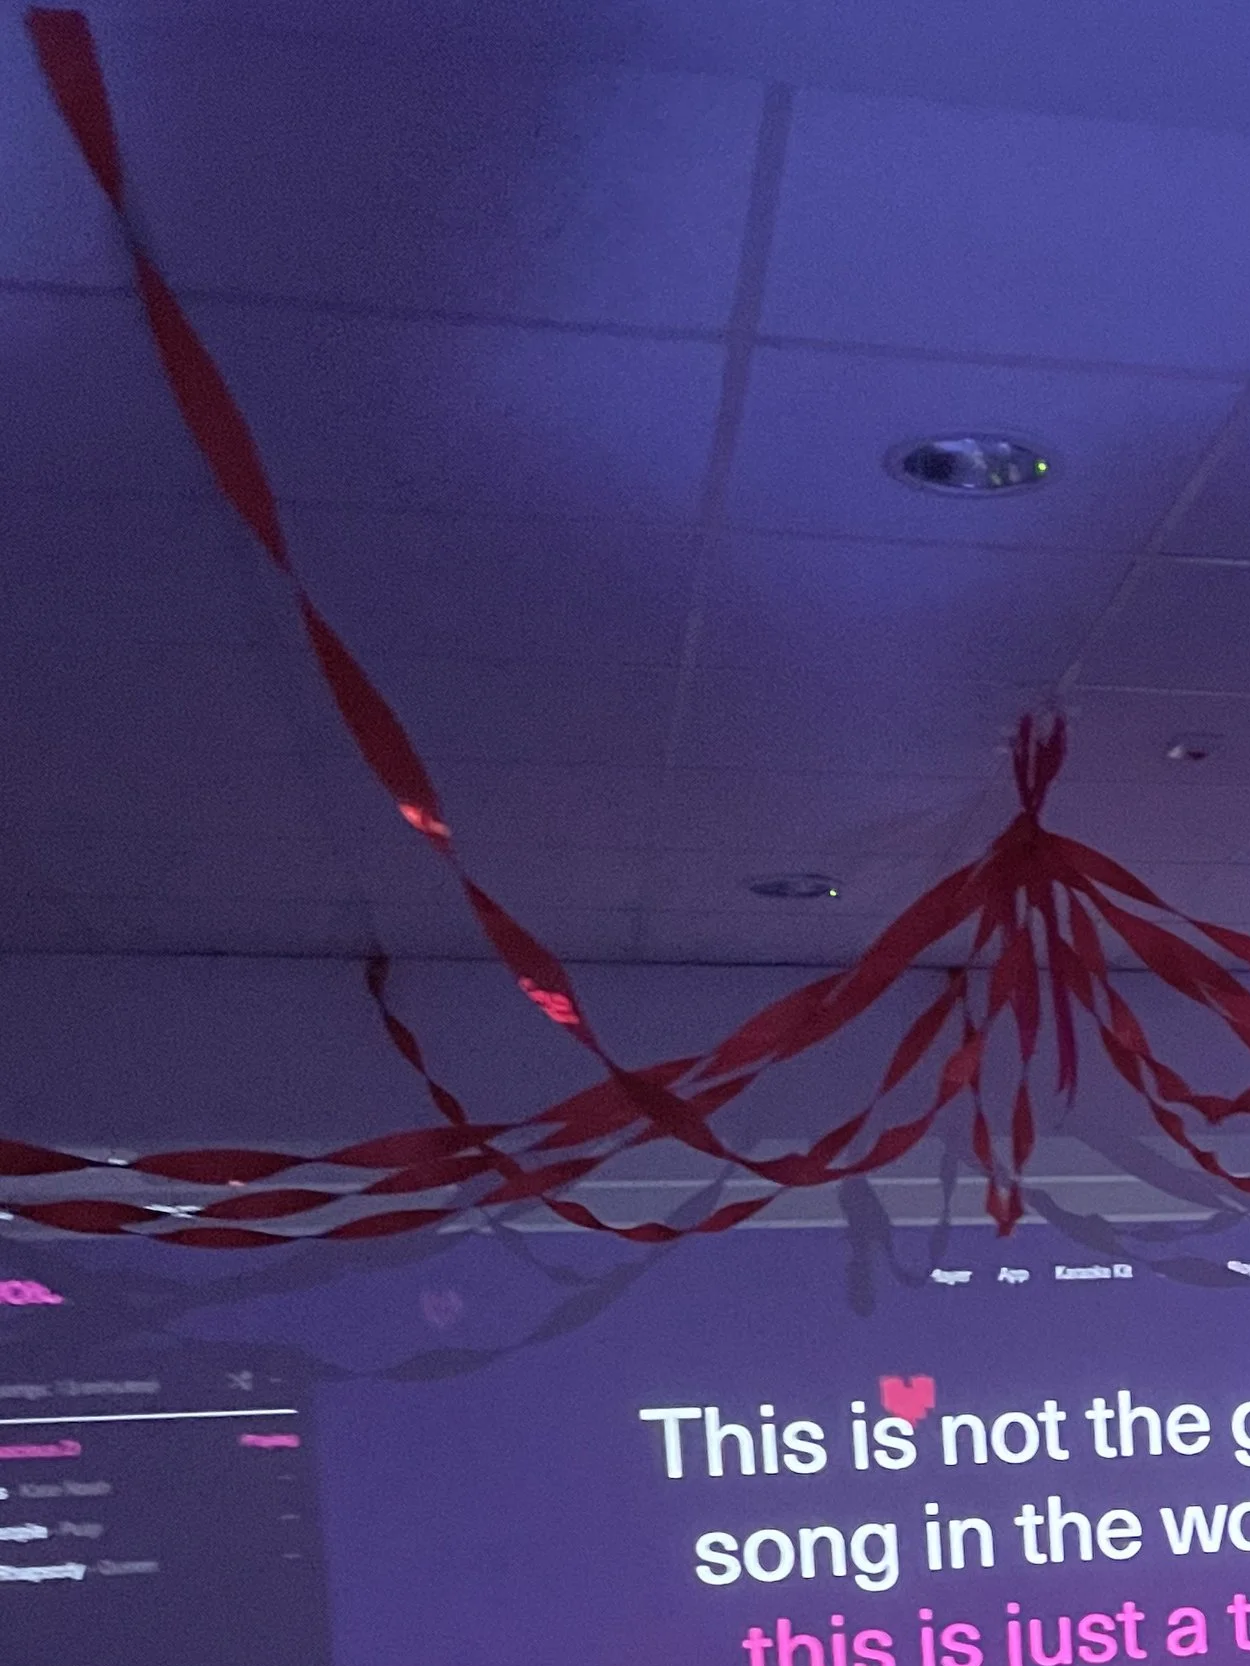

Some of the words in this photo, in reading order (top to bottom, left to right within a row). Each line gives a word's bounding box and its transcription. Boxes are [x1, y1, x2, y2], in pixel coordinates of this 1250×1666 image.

[639, 1405, 829, 1480] This
[851, 1401, 918, 1471] is
[942, 1400, 1071, 1467] not
[1085, 1390, 1212, 1460] the
[696, 1524, 901, 1593] song
[925, 1503, 996, 1572] in
[1014, 1496, 1144, 1566] the
[1167, 1608, 1209, 1658] a
